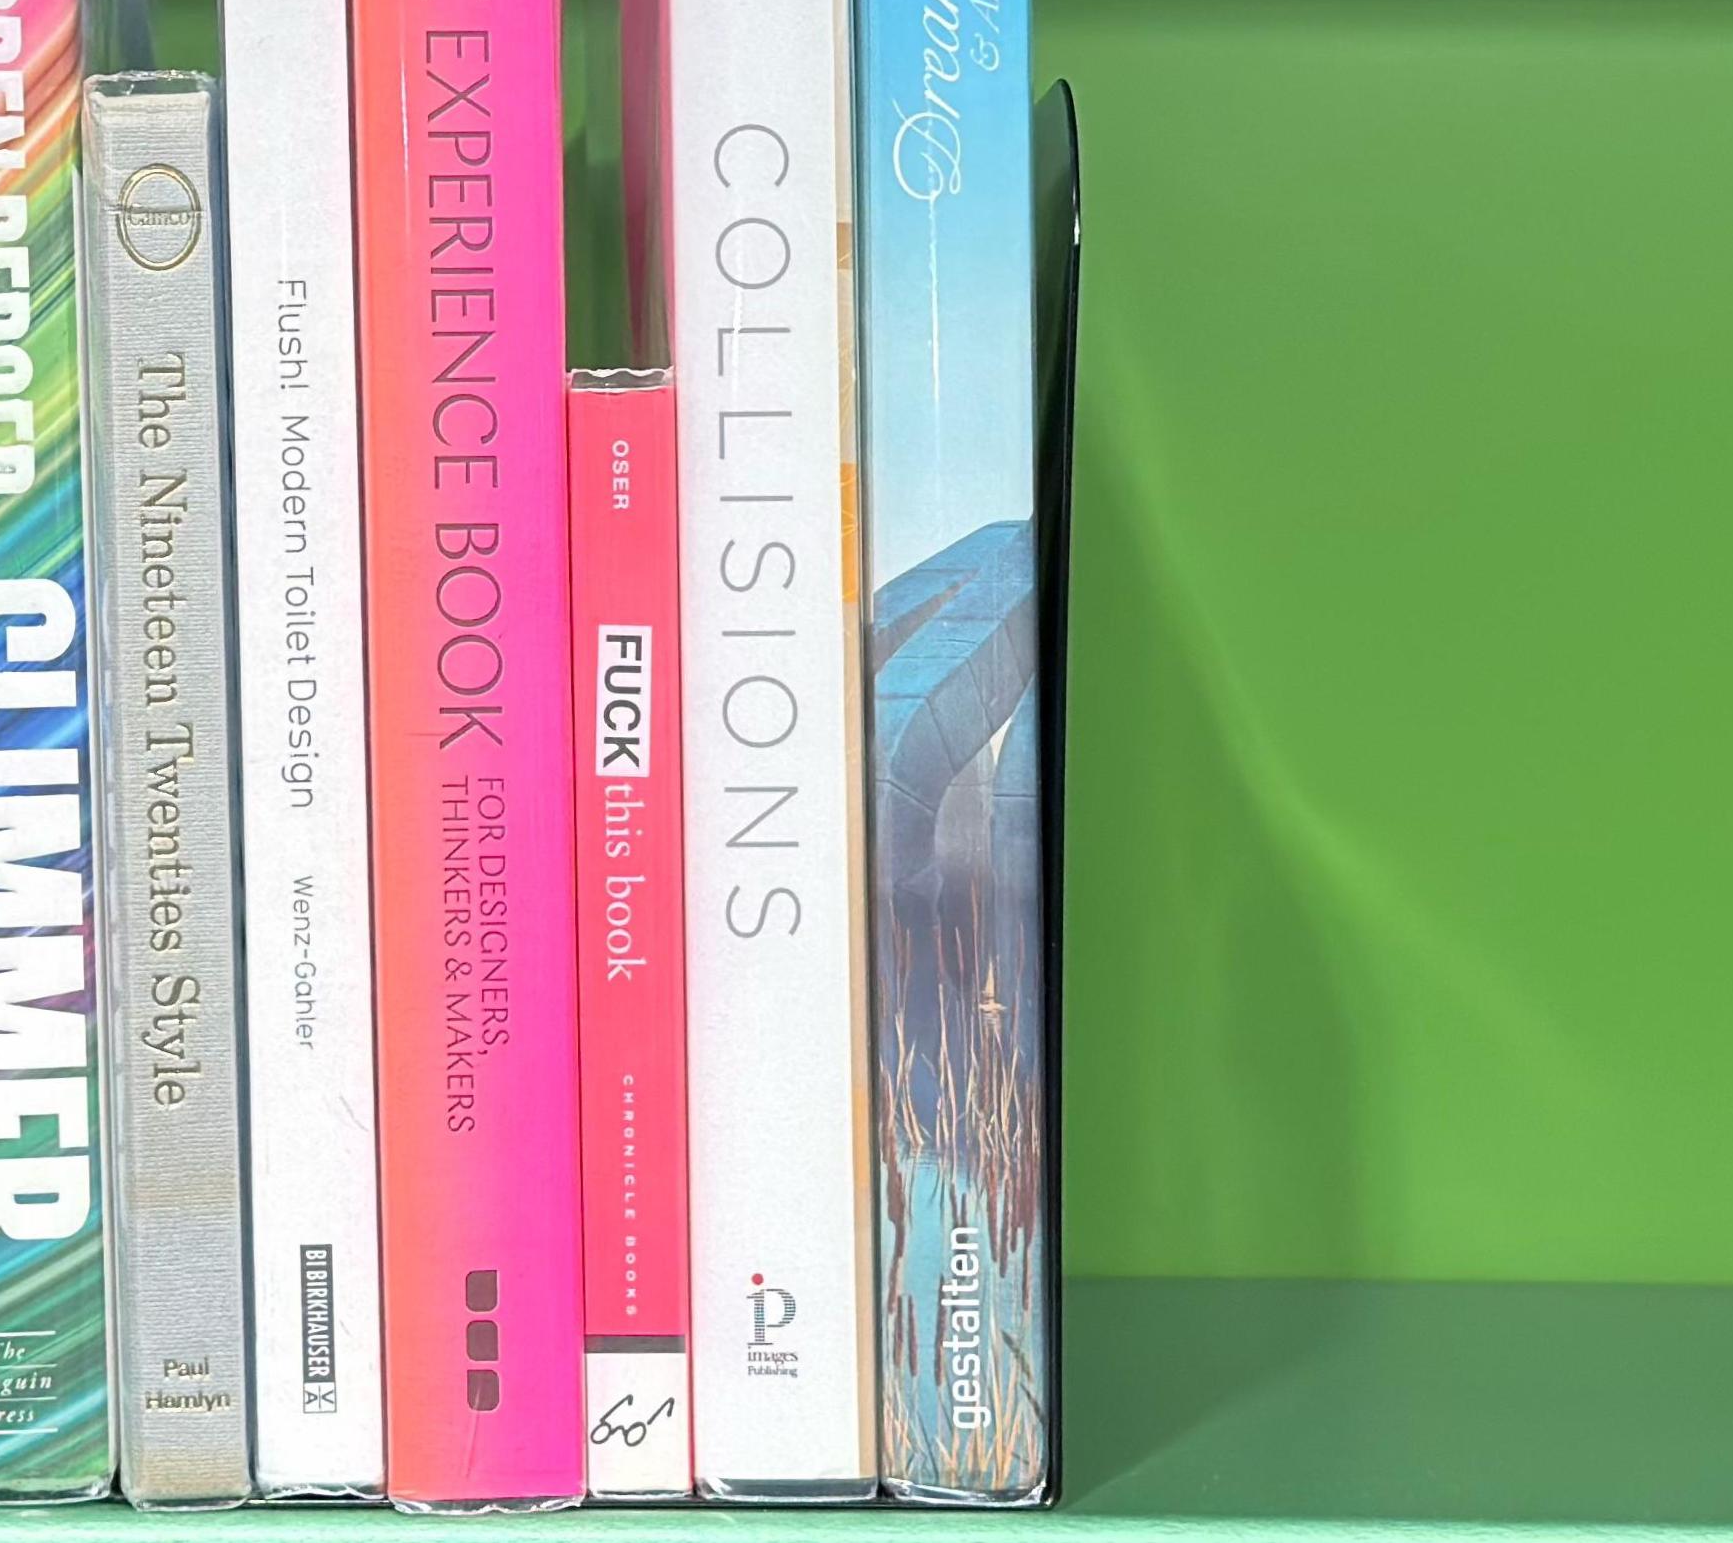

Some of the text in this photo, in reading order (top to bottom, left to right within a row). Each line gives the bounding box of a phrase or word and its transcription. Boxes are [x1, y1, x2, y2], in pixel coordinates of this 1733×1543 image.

[970, 33, 1000, 71] &
[425, 30, 499, 488] EXPERIENCE
[277, 278, 319, 809] Flush! Modern Toilet Design
[612, 440, 629, 512] OSER
[713, 122, 801, 940] COLLISIONS
[136, 354, 202, 1108] The Nineteen Twenties Style
[435, 522, 504, 750] BOOK
[478, 777, 509, 1055] FOR DESIGNERS,
[602, 633, 644, 982] FUCK this book
[442, 775, 476, 1133] THINKERS & MAKERS
[623, 1075, 637, 1316] CHRONICLE BOOKS
[145, 1390, 230, 1411] Hamlyn
[163, 1357, 209, 1377] Paul
[306, 1271, 330, 1377] BIRKHAUSER
[747, 1346, 798, 1365] images
[747, 1365, 798, 1378] Publishing
[940, 1226, 991, 1430] gestalten
